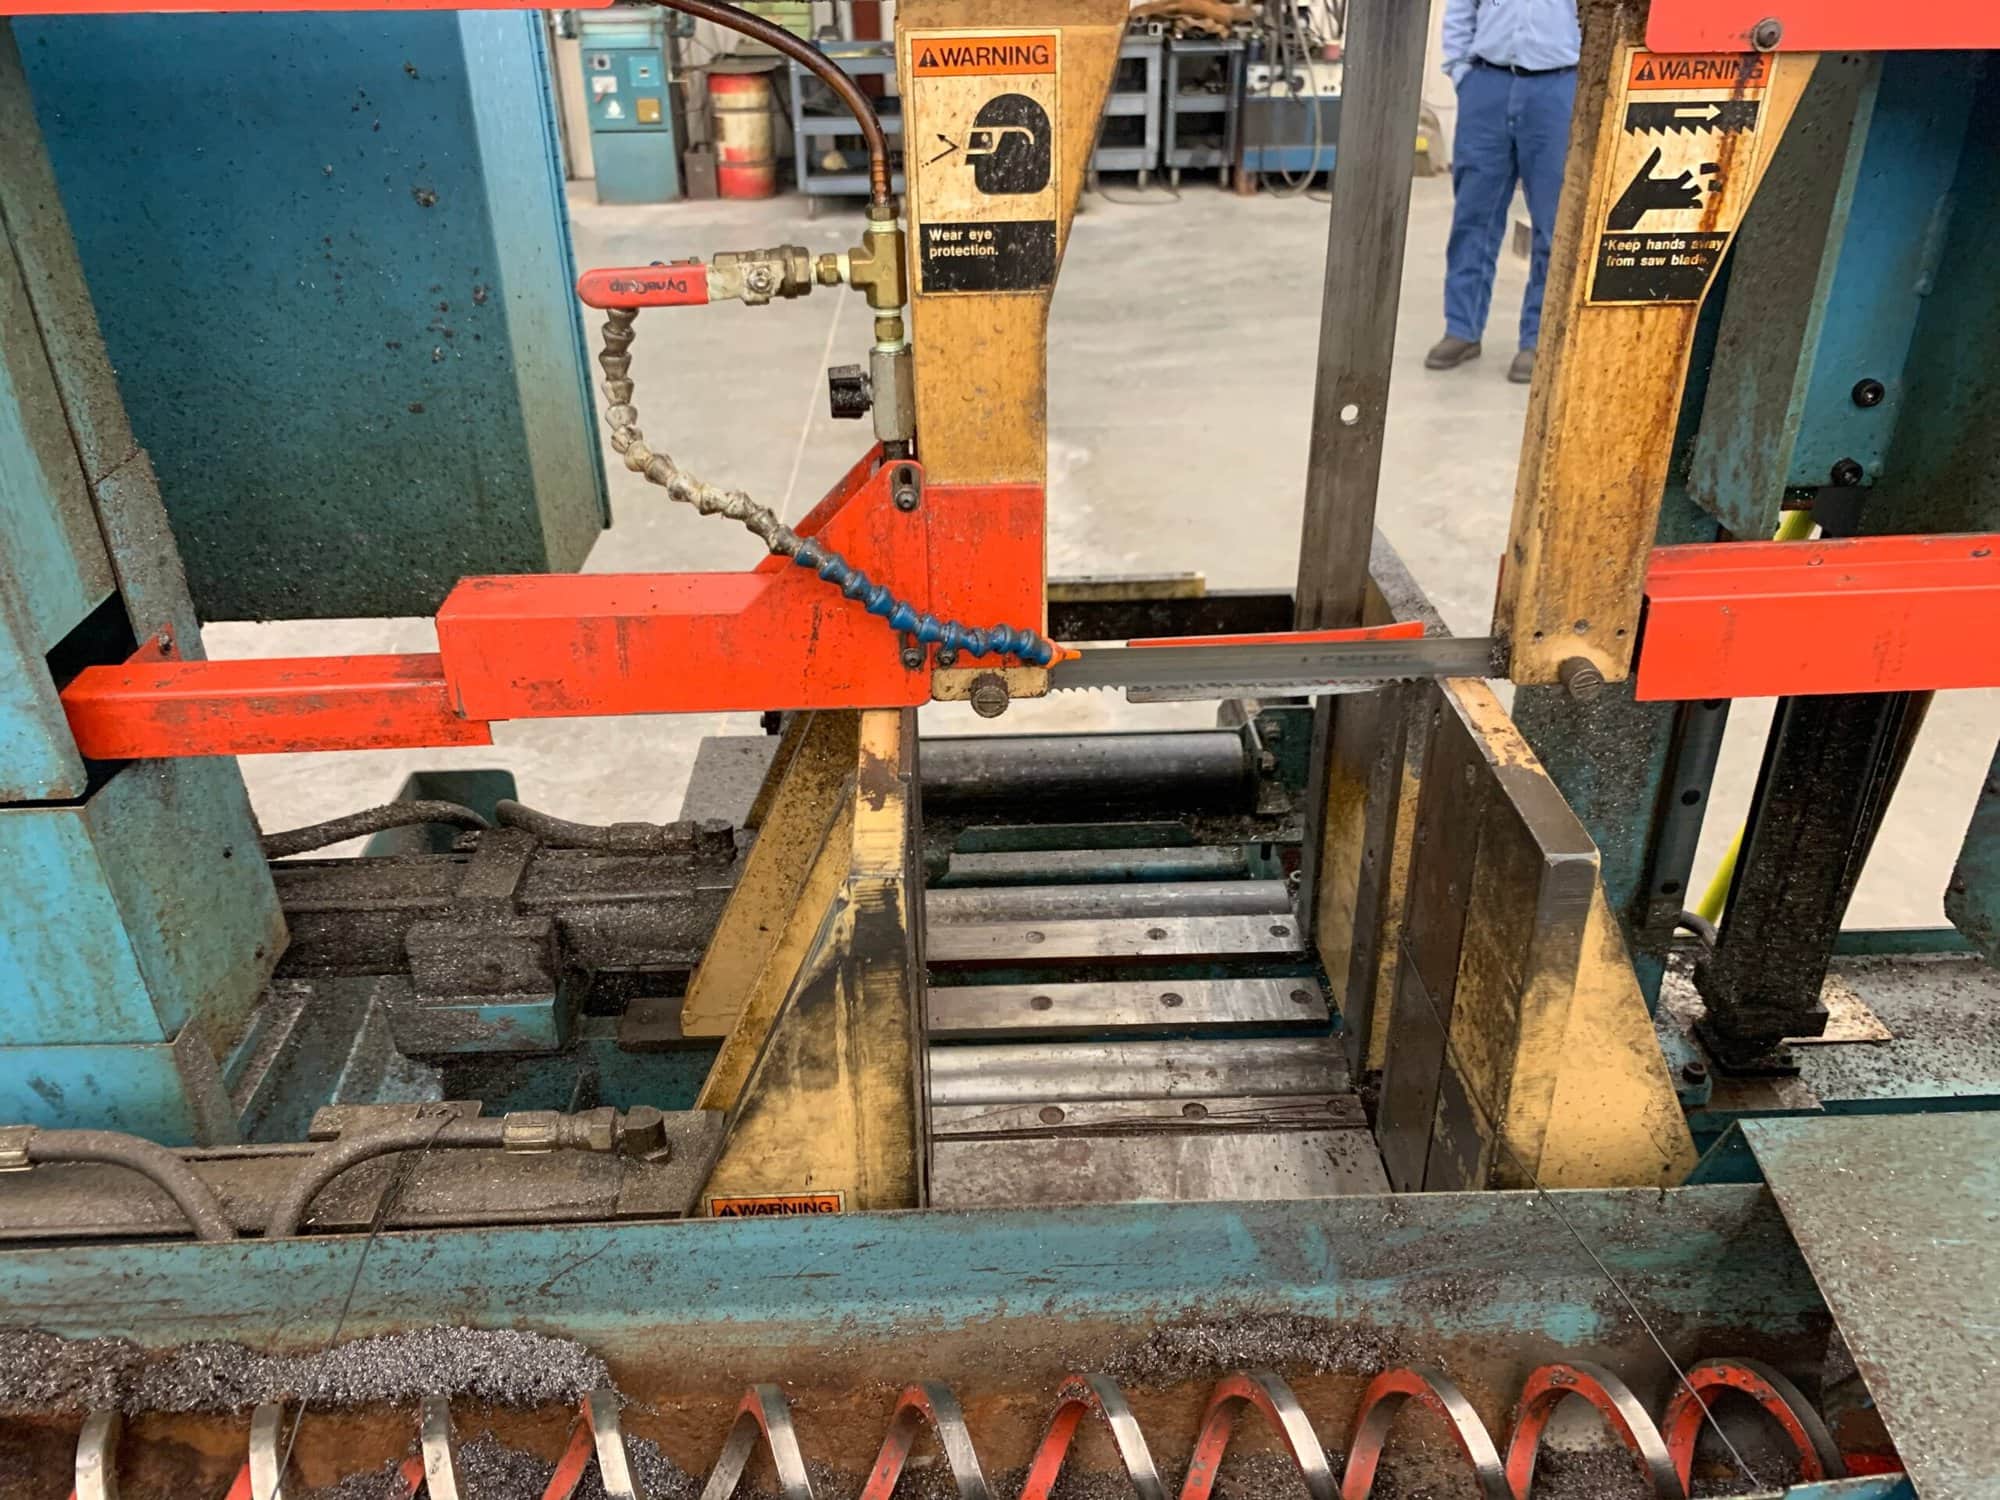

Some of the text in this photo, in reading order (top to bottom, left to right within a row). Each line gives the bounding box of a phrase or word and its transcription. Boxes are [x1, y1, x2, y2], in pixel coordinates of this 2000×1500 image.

[939, 45, 1049, 67] WARNING
[1659, 60, 1764, 80] WARNING
[929, 229, 993, 243] Wear eye
[929, 243, 999, 260] protection.
[1607, 239, 1641, 253] Keep
[1646, 239, 1686, 250] hands
[1606, 254, 1636, 267] from
[1640, 256, 1667, 266] saw
[738, 1201, 833, 1217] WARNING
